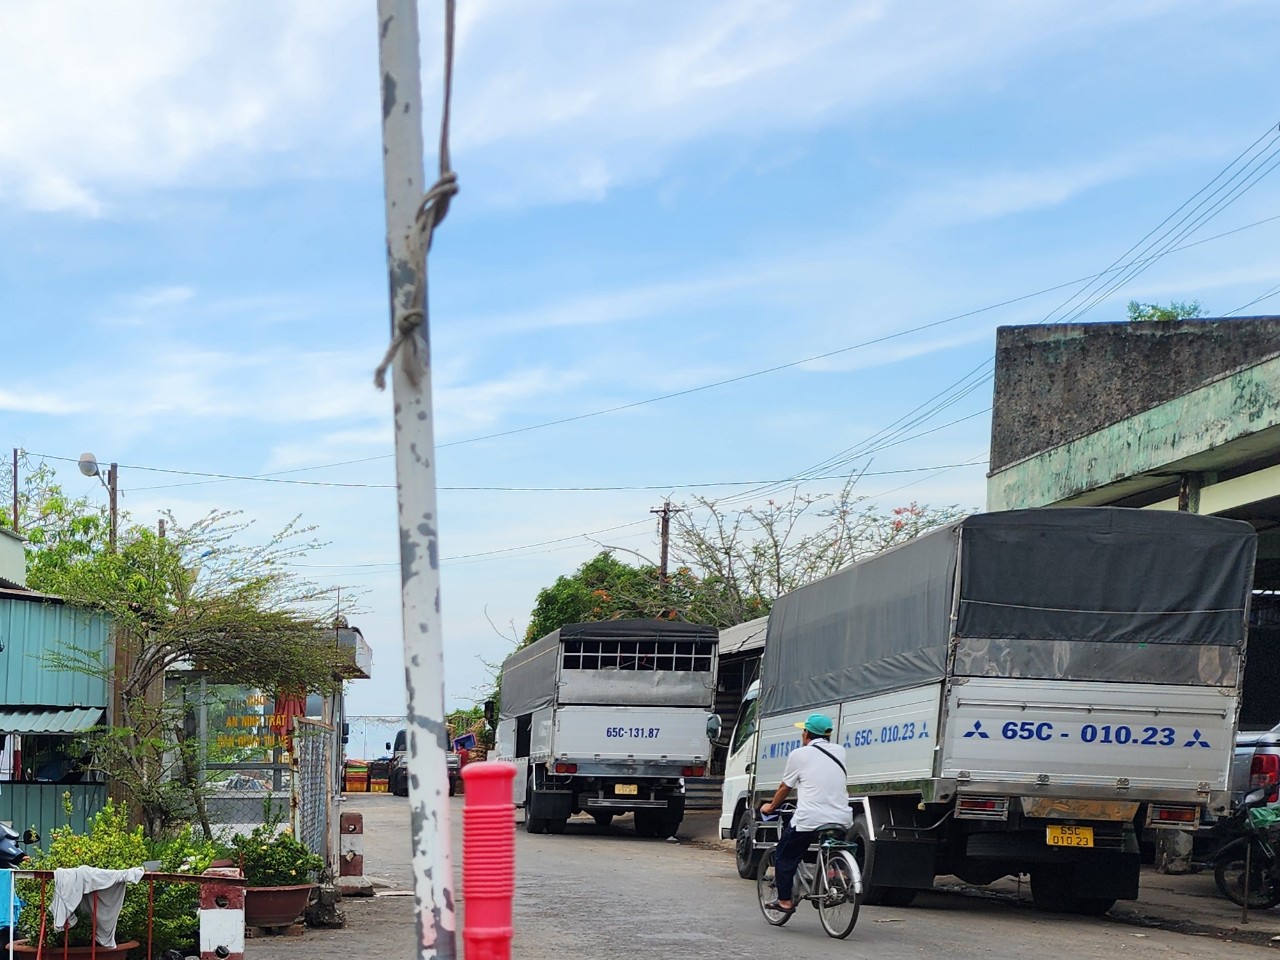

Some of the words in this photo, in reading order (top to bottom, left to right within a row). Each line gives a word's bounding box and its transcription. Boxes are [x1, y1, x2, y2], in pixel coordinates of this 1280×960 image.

[606, 726, 660, 740] 65C-131.87
[855, 729, 872, 747] 65C
[881, 722, 915, 743] 010.23
[1001, 720, 1054, 741] 65C
[1080, 723, 1176, 746] 010.23
[770, 740, 801, 758] MITSUB
[1061, 826, 1080, 835] 65C
[1053, 836, 1088, 845] 010.23
